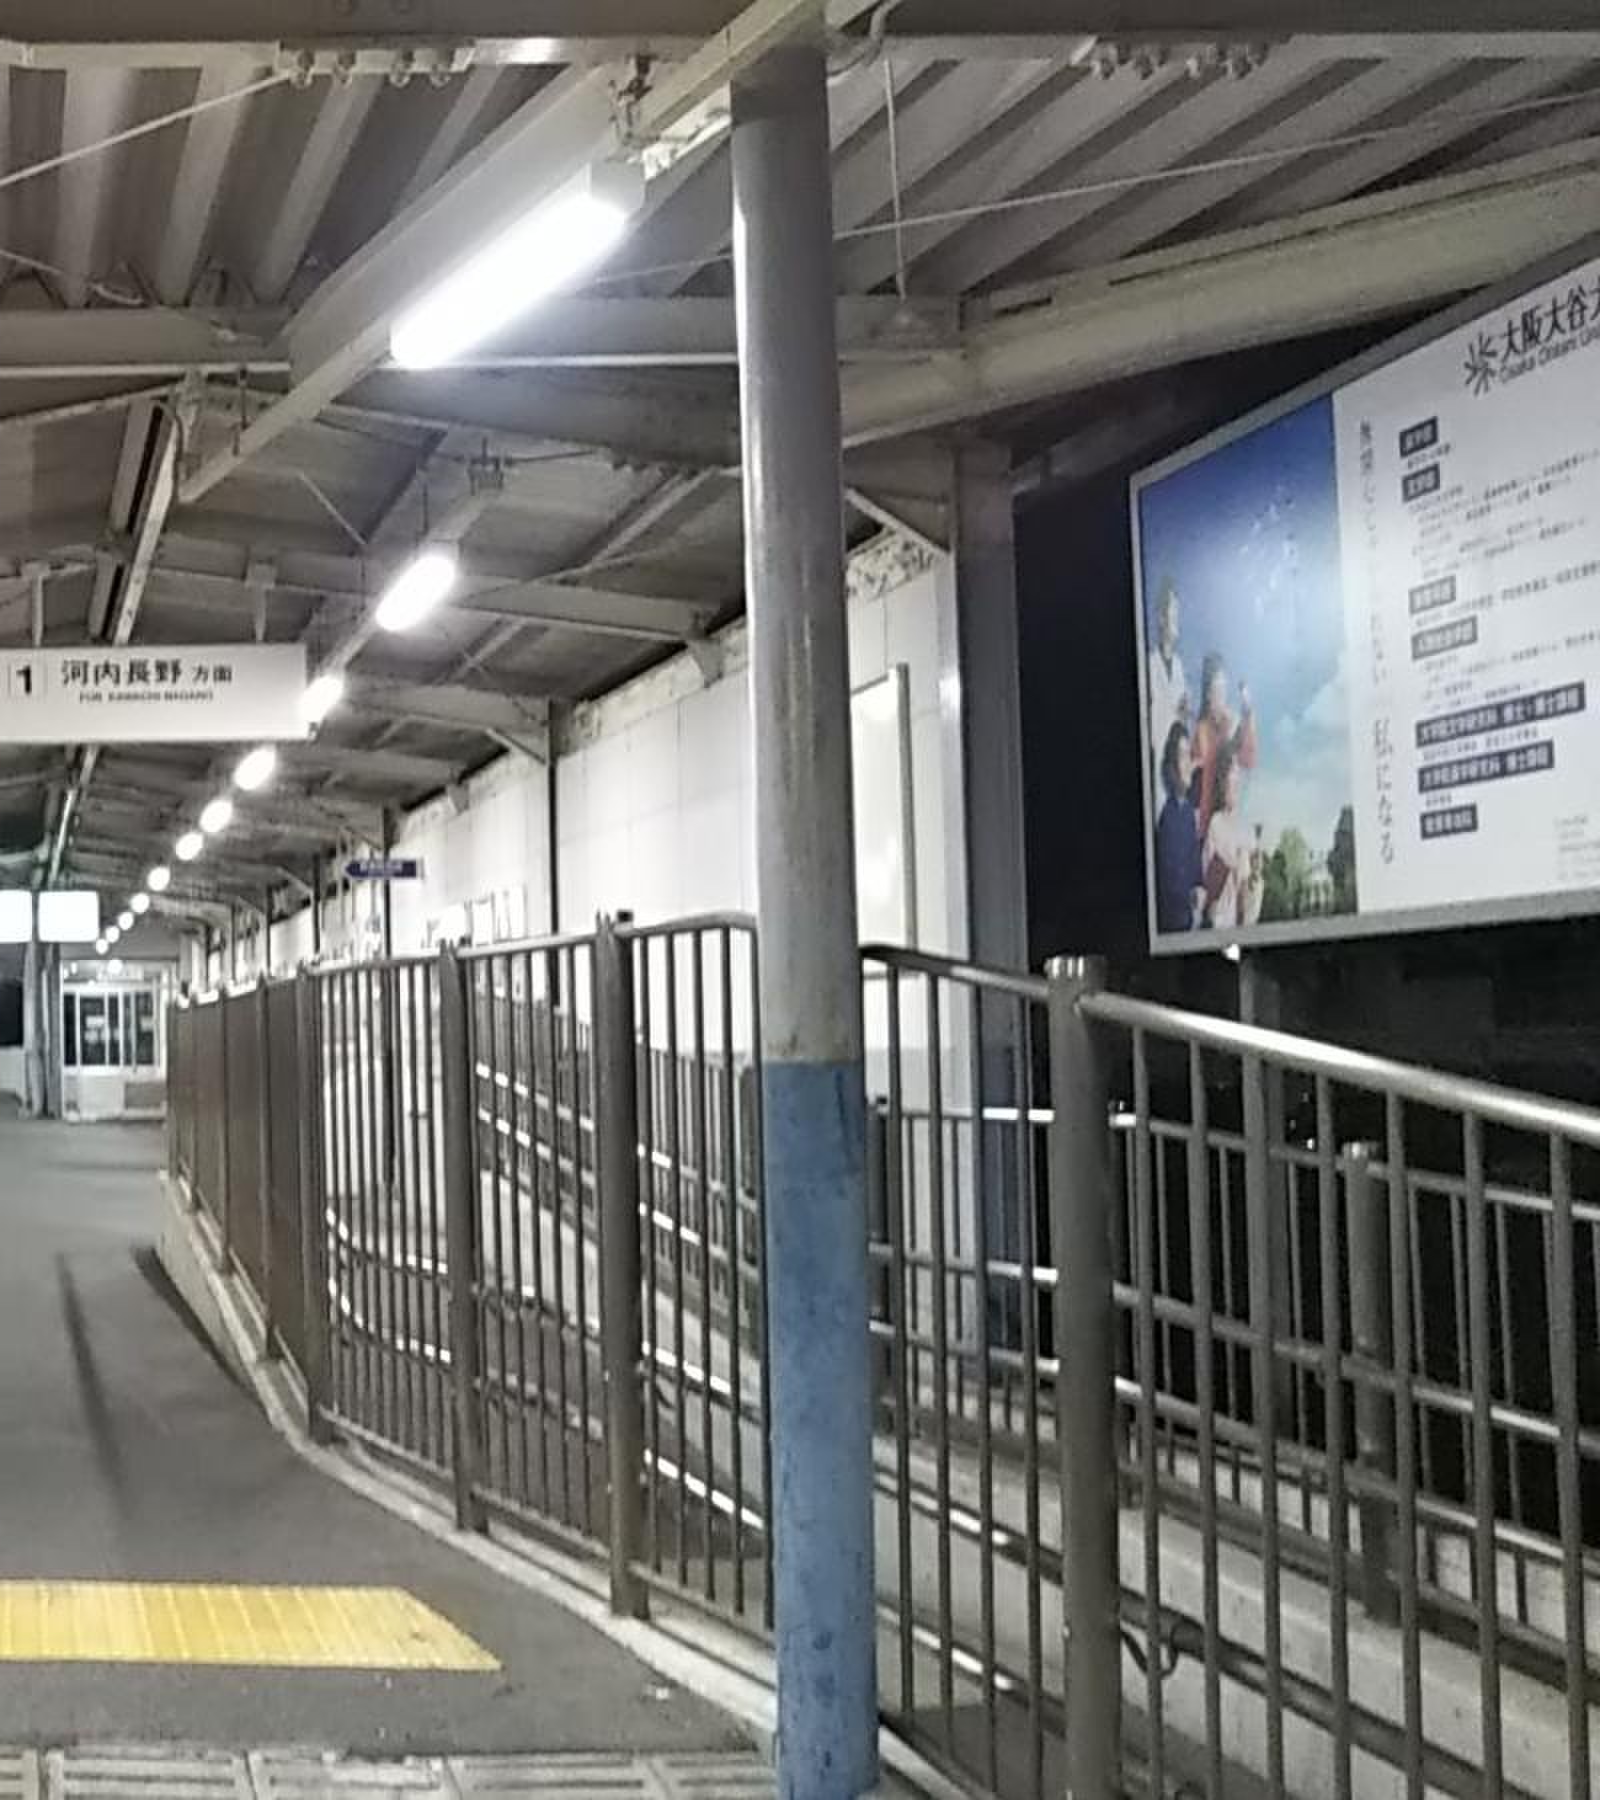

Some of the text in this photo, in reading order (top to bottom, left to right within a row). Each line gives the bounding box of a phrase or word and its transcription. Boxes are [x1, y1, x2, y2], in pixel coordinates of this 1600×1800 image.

[16, 664, 33, 696] 1
[61, 658, 233, 686] 河内長野 方面
